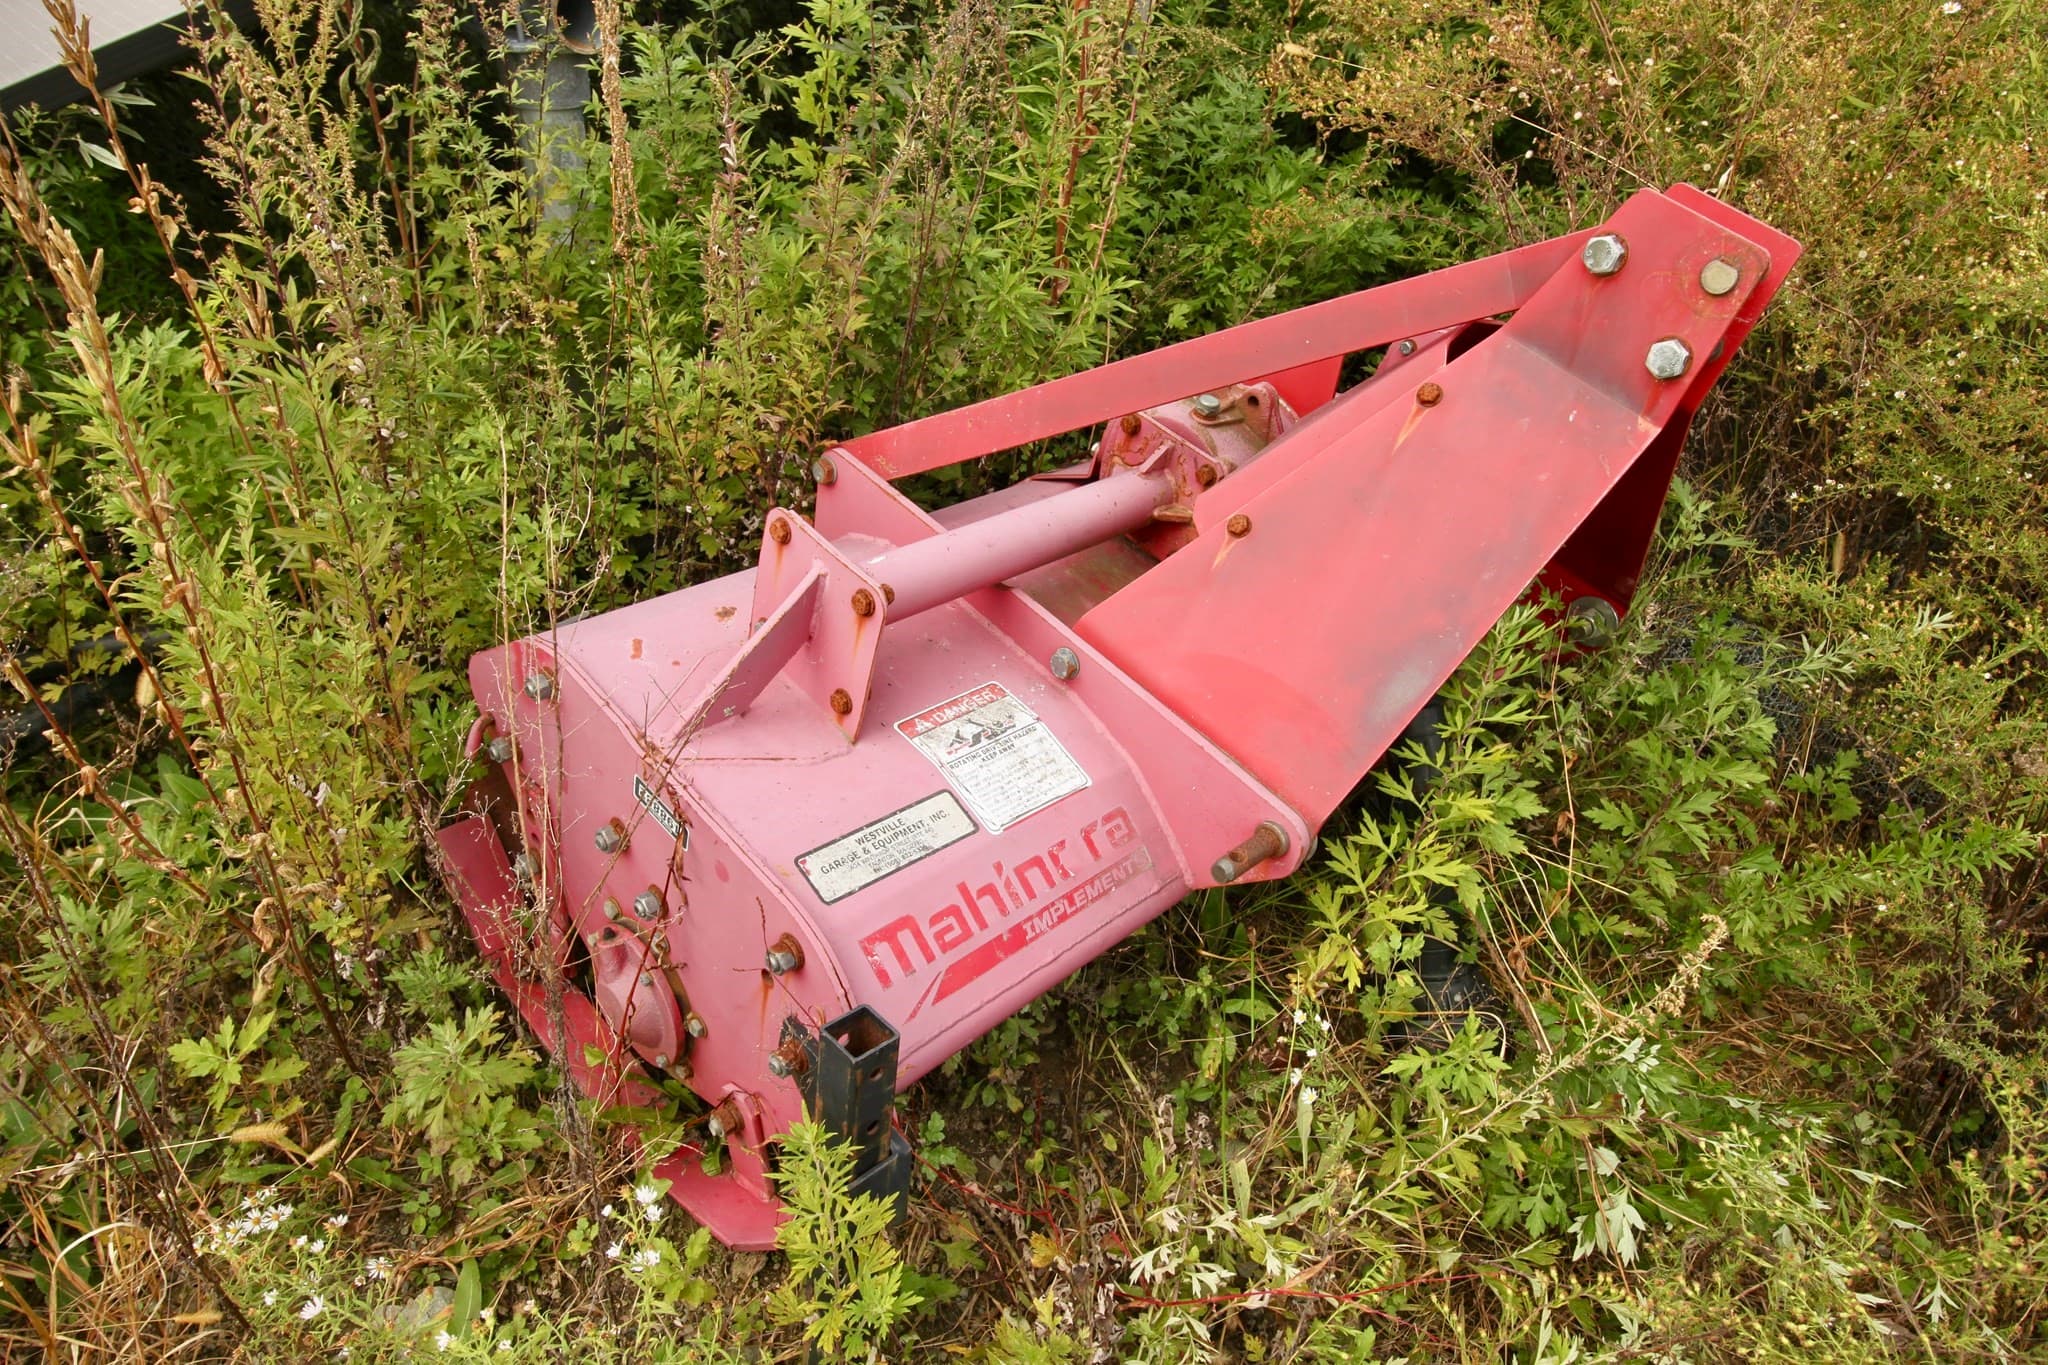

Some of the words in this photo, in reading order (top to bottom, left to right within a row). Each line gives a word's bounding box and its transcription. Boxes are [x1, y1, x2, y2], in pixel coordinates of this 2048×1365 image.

[933, 690, 996, 723] DANGER
[949, 751, 982, 770] ROTATING
[1012, 726, 1038, 743] HAZARD
[981, 750, 998, 763] KEEP
[998, 743, 1016, 757] AWAY
[854, 818, 906, 846] WESTVILLE
[863, 847, 871, 855] &
[871, 820, 930, 850] EQUIPMENT,
[930, 809, 950, 824] INC.
